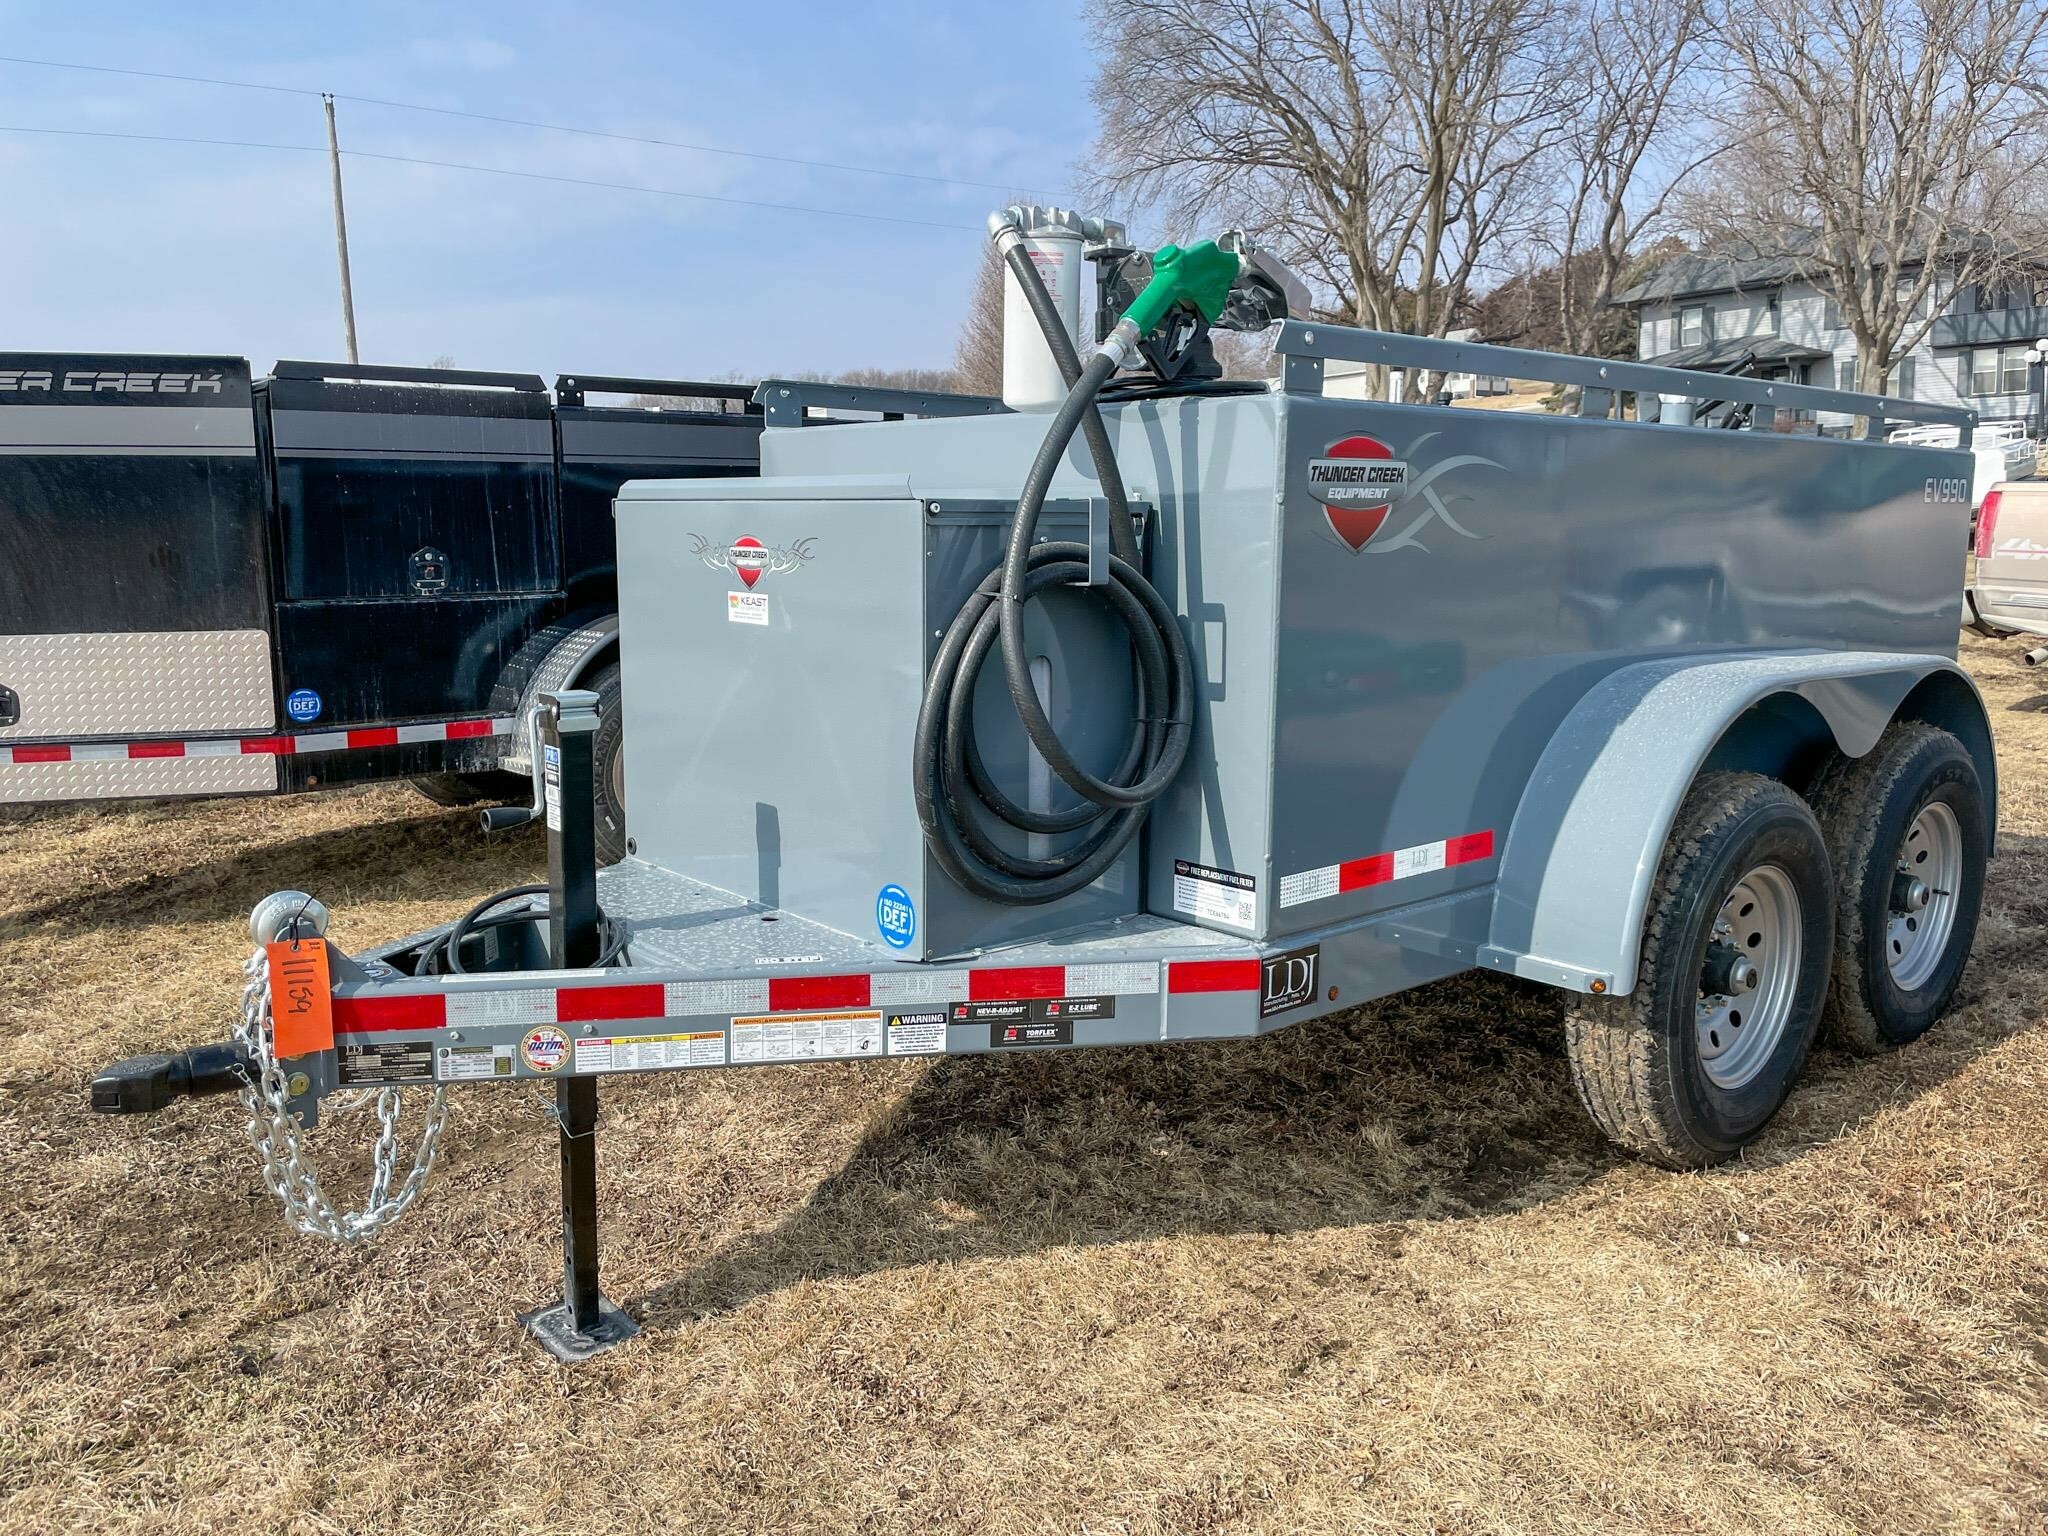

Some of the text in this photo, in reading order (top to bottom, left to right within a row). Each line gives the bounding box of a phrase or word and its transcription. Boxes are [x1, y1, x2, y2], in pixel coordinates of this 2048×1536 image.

[63, 371, 222, 393] CREEK
[1310, 465, 1406, 484] THUNDER CREEK
[1327, 487, 1389, 500] EQUIPMENT
[1923, 477, 1967, 503] EV990
[730, 550, 768, 560] THUNDER CREEK
[740, 596, 767, 607] KEAST
[293, 701, 316, 711] DEF
[1190, 867, 1201, 876] FREE
[1201, 868, 1229, 881] REPLACEMENT
[1229, 874, 1239, 885] FUEL
[1239, 877, 1254, 888] FILTER
[883, 898, 909, 912] ISO 22241
[883, 906, 908, 928] DEF
[883, 922, 908, 935] COMPLIANT
[1264, 953, 1318, 1002] LDJ
[901, 1013, 944, 1025] WARNING
[1026, 1029, 1056, 1037] TORFLEX
[345, 1046, 363, 1055] LDJ
